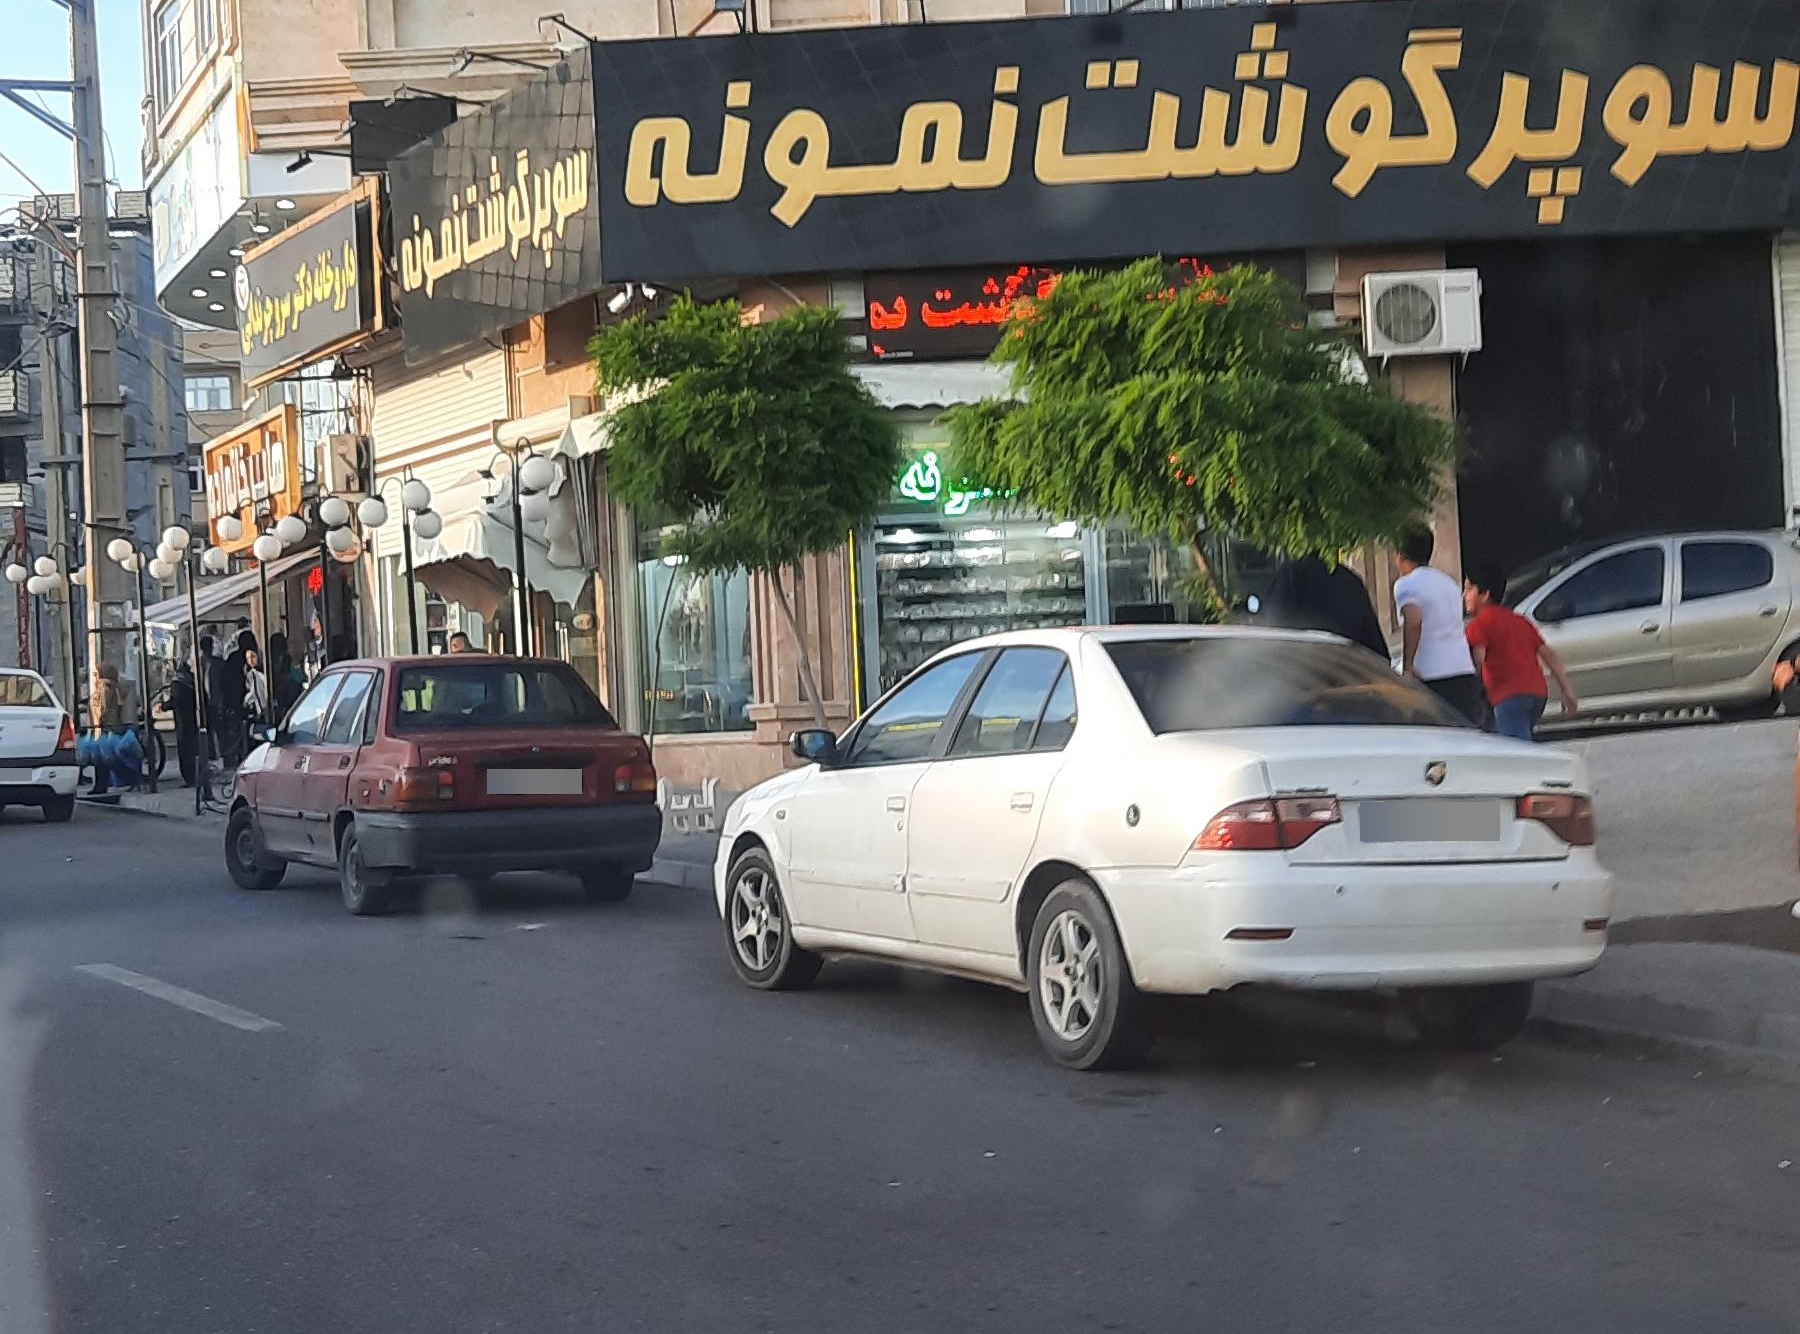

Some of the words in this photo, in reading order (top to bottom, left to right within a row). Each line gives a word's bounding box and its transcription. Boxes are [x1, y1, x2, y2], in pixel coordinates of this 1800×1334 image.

[624, 64, 1021, 228] نمونه
[314, 239, 356, 313] داروخانه
[402, 193, 463, 299] نمونه
